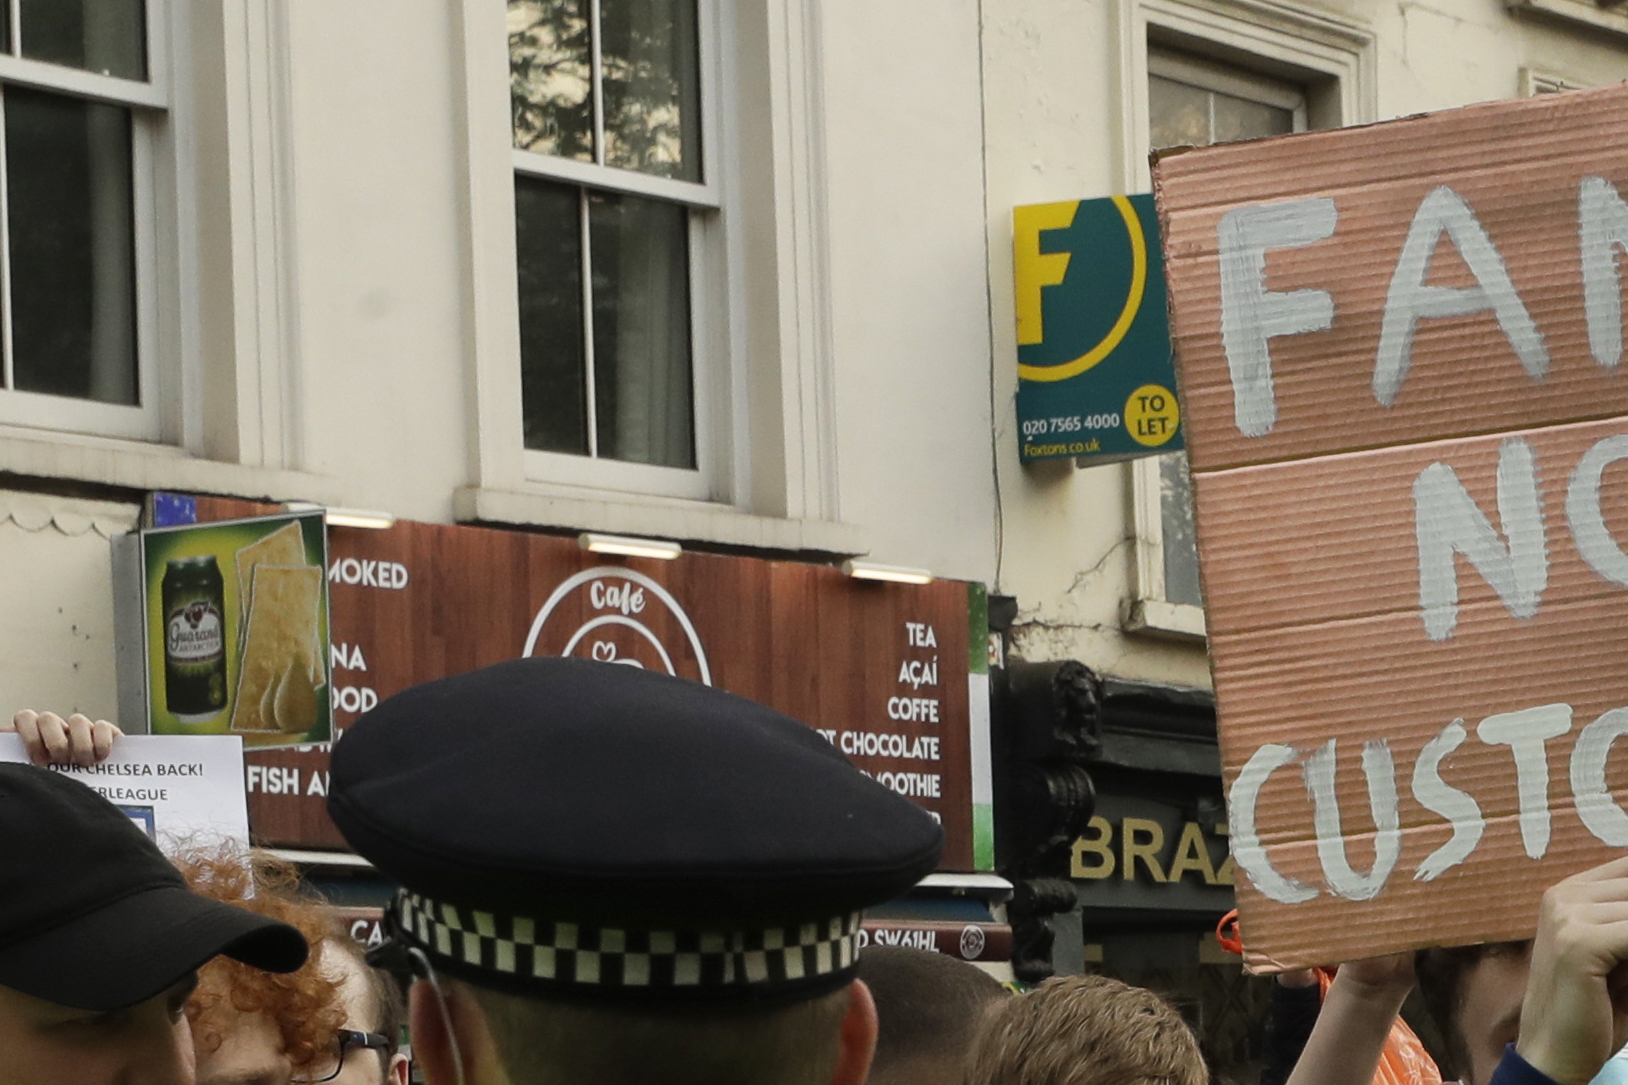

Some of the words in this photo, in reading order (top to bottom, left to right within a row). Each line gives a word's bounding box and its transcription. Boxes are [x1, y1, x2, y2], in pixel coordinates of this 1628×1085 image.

[1138, 395, 1165, 413] TO
[1023, 419, 1048, 435] 020
[1049, 416, 1081, 433] 7565
[1084, 413, 1120, 429] 4000
[1138, 417, 1169, 436] LET
[590, 580, 646, 615] Café
[906, 622, 937, 648] TEA
[898, 655, 938, 690] AÇAÍ
[887, 696, 939, 723] COFFE
[840, 730, 940, 760] CHOCOLATE
[85, 763, 153, 776] CHELSEA
[157, 763, 203, 776] BACK!
[247, 765, 299, 795] FISH
[860, 769, 941, 798] OOTHIE
